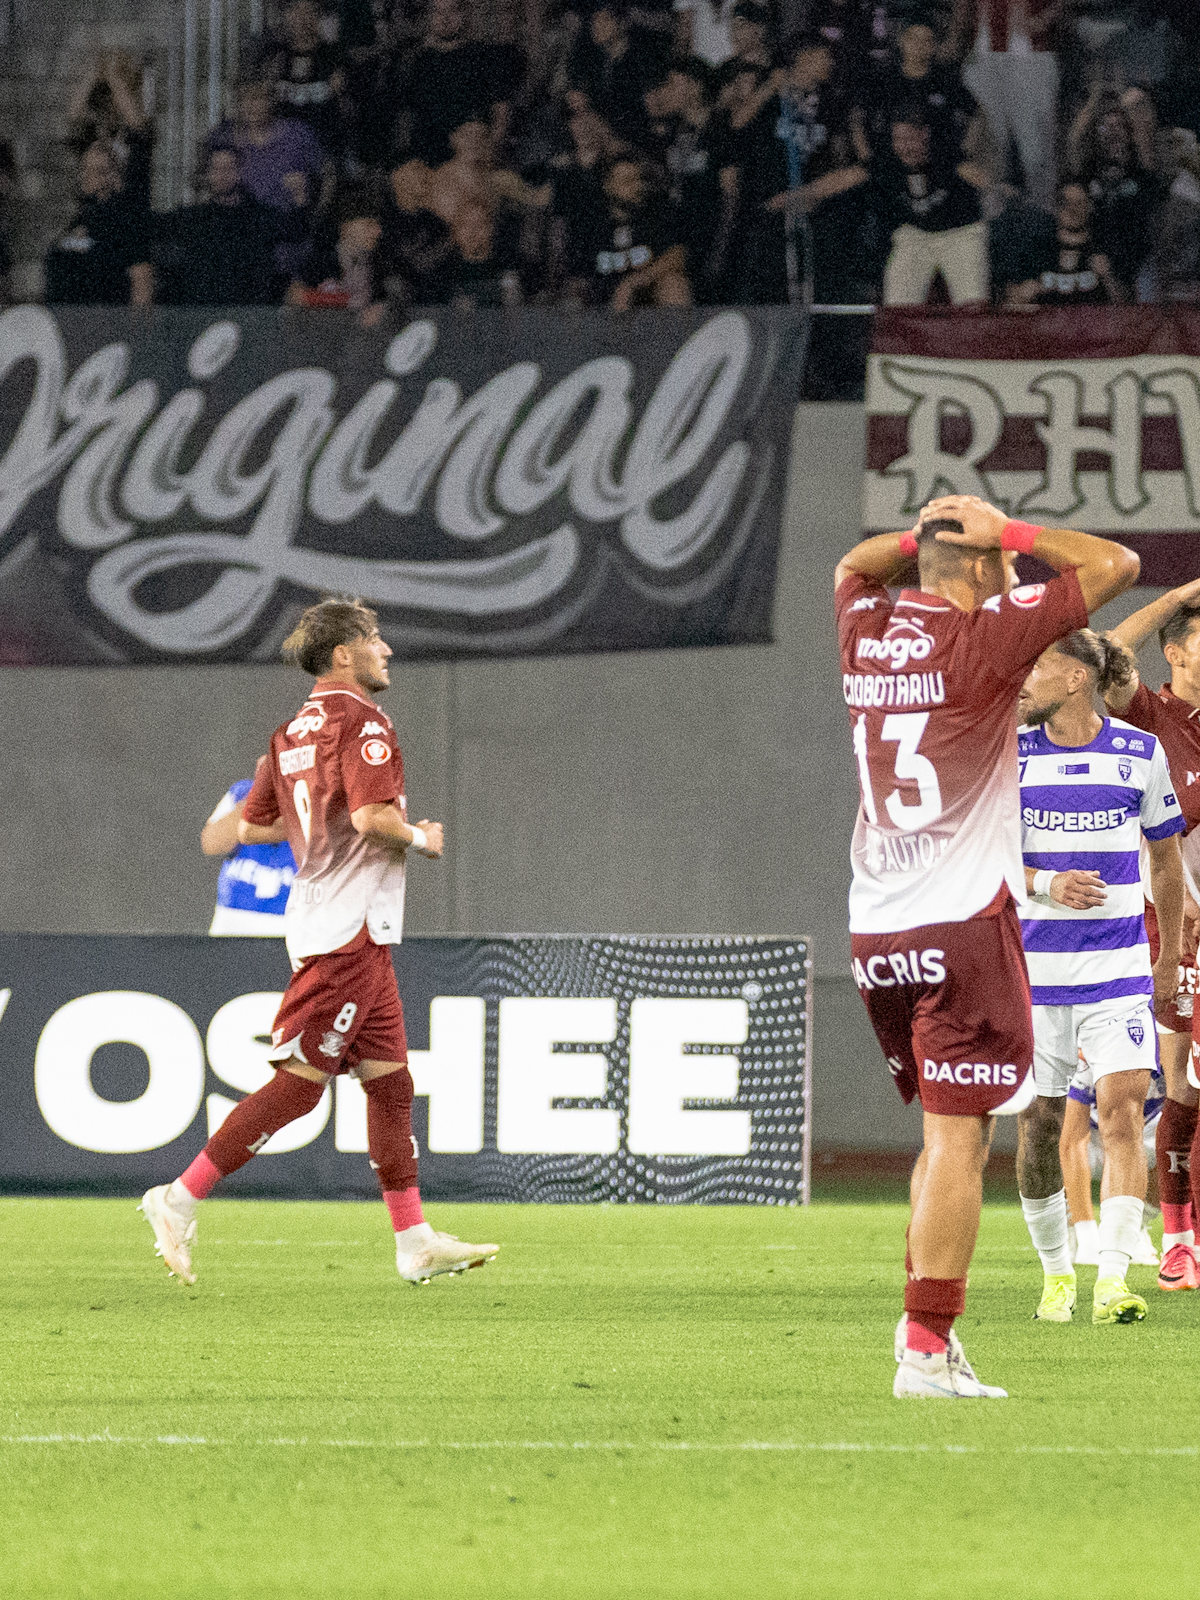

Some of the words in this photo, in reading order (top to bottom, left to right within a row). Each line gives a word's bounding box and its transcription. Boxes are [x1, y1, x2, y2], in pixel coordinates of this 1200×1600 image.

[857, 636, 932, 669] mogo
[853, 712, 942, 831] 13
[1022, 807, 1129, 832] SUPERBET
[851, 948, 947, 989] ACRIS
[333, 1001, 358, 1033] 8
[33, 990, 752, 1156] OSHEE
[923, 1058, 1018, 1086] DACRIS
